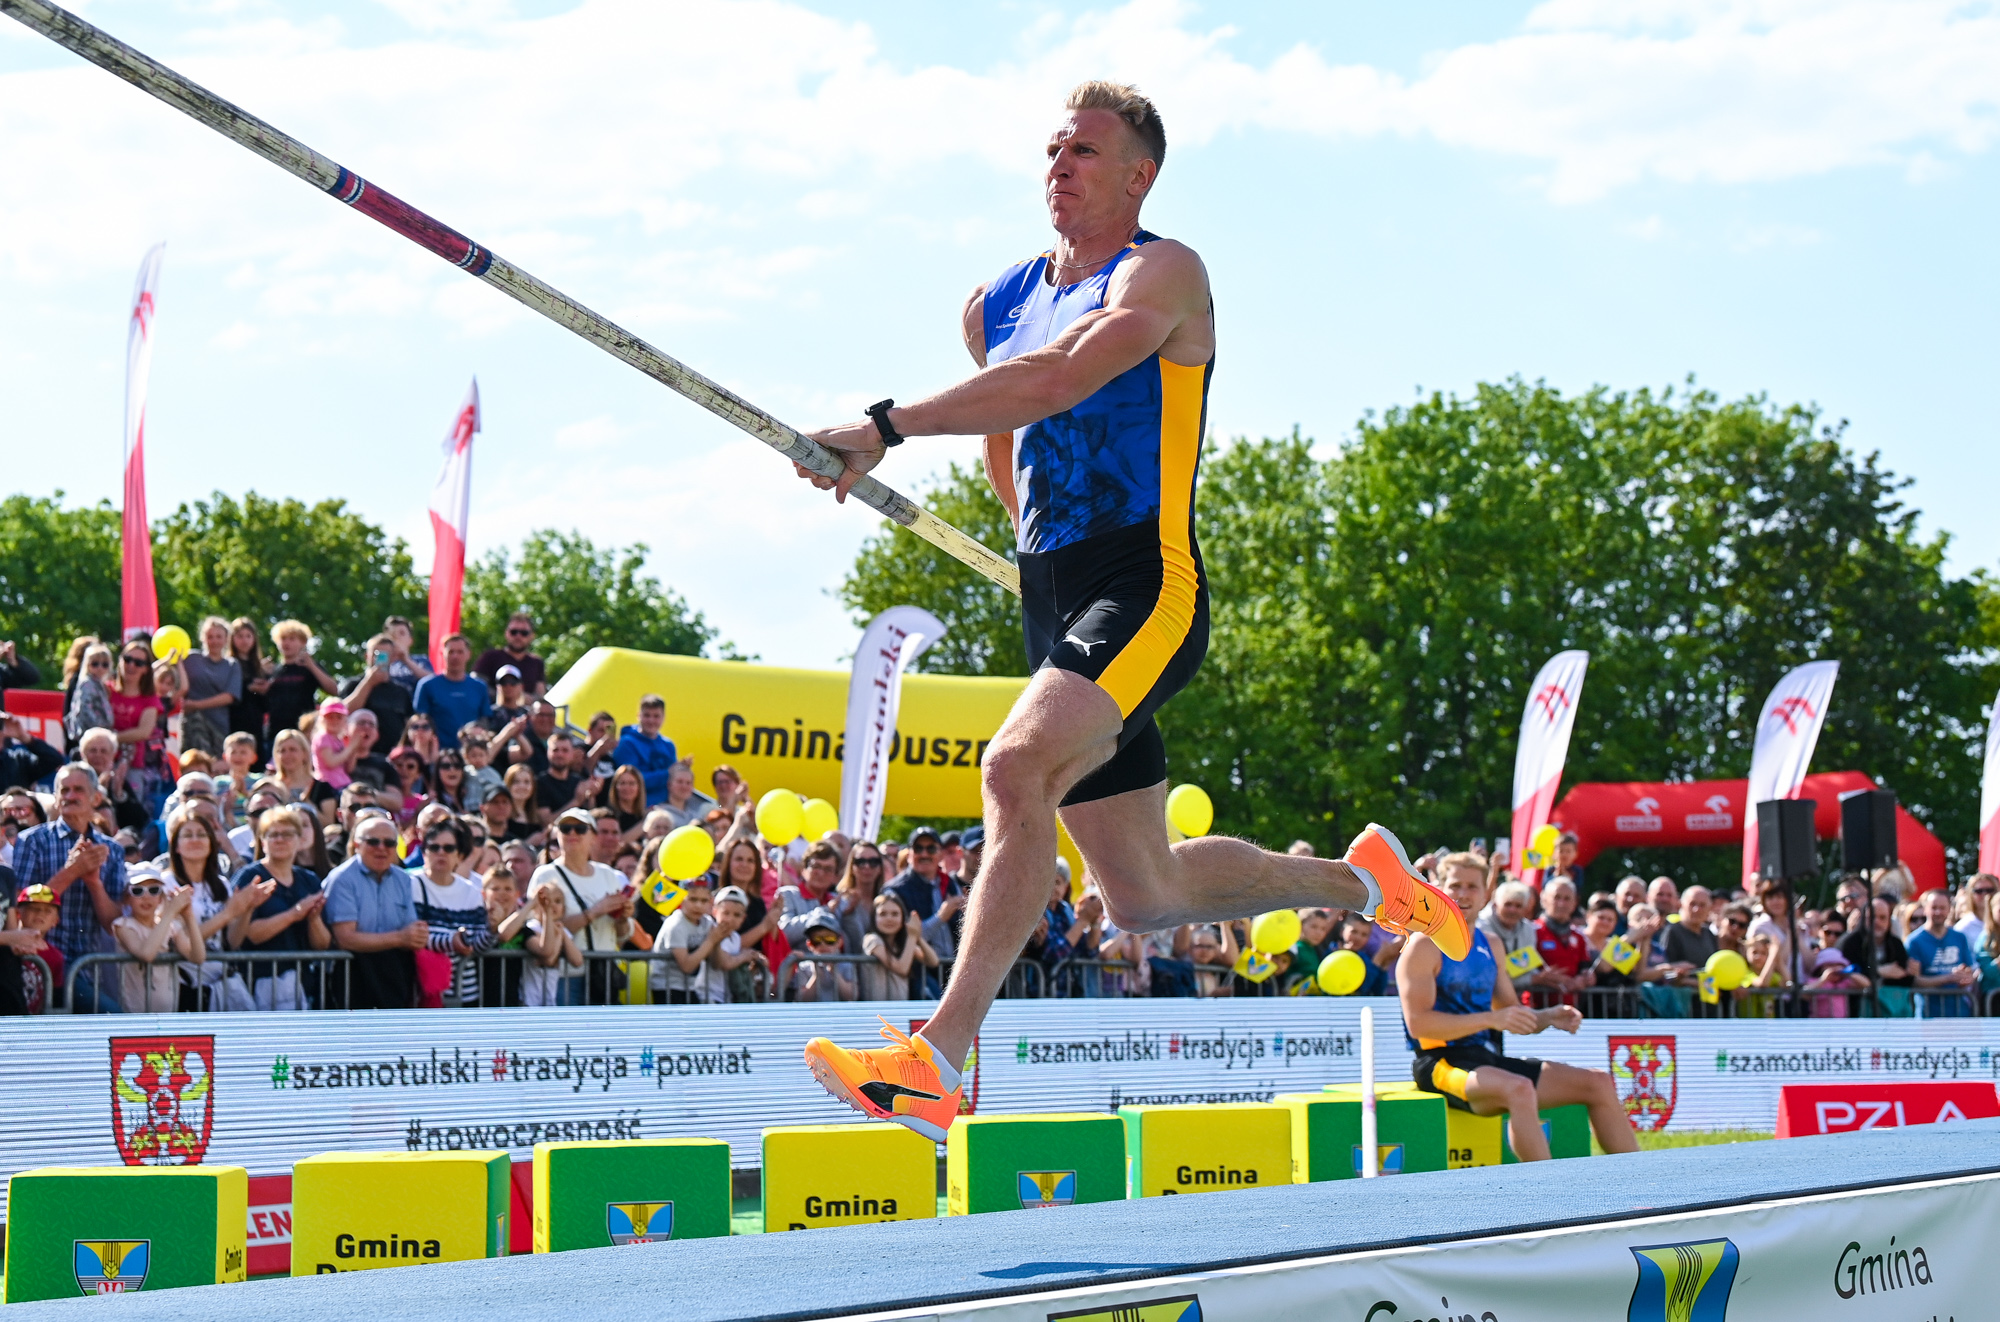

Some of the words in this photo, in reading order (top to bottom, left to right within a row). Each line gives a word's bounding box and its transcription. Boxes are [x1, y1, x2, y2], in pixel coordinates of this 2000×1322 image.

[1016, 1029, 1161, 1064] #szamotulski
[1169, 1028, 1266, 1070] #tradycja
[1273, 1027, 1354, 1068] #powiat
[1716, 1046, 1862, 1073] #szamotulski
[1871, 1046, 1971, 1079] #tradycja
[271, 1046, 480, 1089] #szamotulski
[492, 1044, 627, 1093] #tradycja
[640, 1044, 752, 1090] #powiat
[1176, 1165, 1258, 1185] Gmina
[805, 1195, 897, 1218] Gmina
[335, 1233, 441, 1258] Gmina
[1834, 1235, 1934, 1300] Gmina
